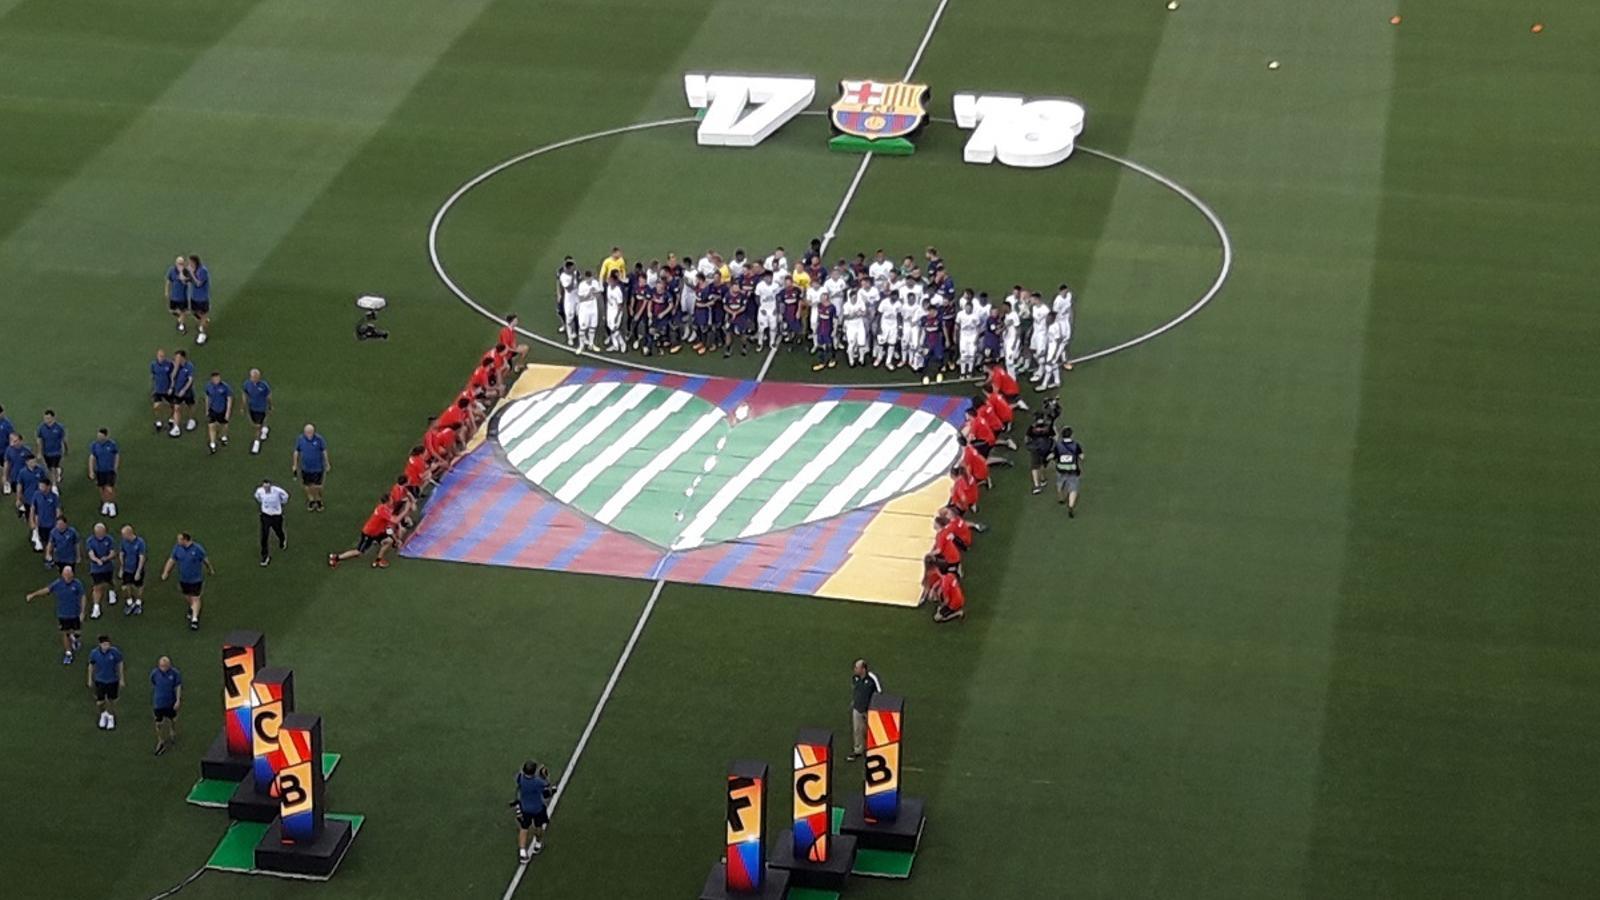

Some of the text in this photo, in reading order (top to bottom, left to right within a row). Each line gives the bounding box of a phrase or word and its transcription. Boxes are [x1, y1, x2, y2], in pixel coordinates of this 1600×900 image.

[222, 646, 248, 699] F
[254, 711, 279, 745] C
[865, 753, 893, 788] B
[279, 773, 308, 809] B
[727, 777, 756, 833] F
[796, 773, 828, 808] C
